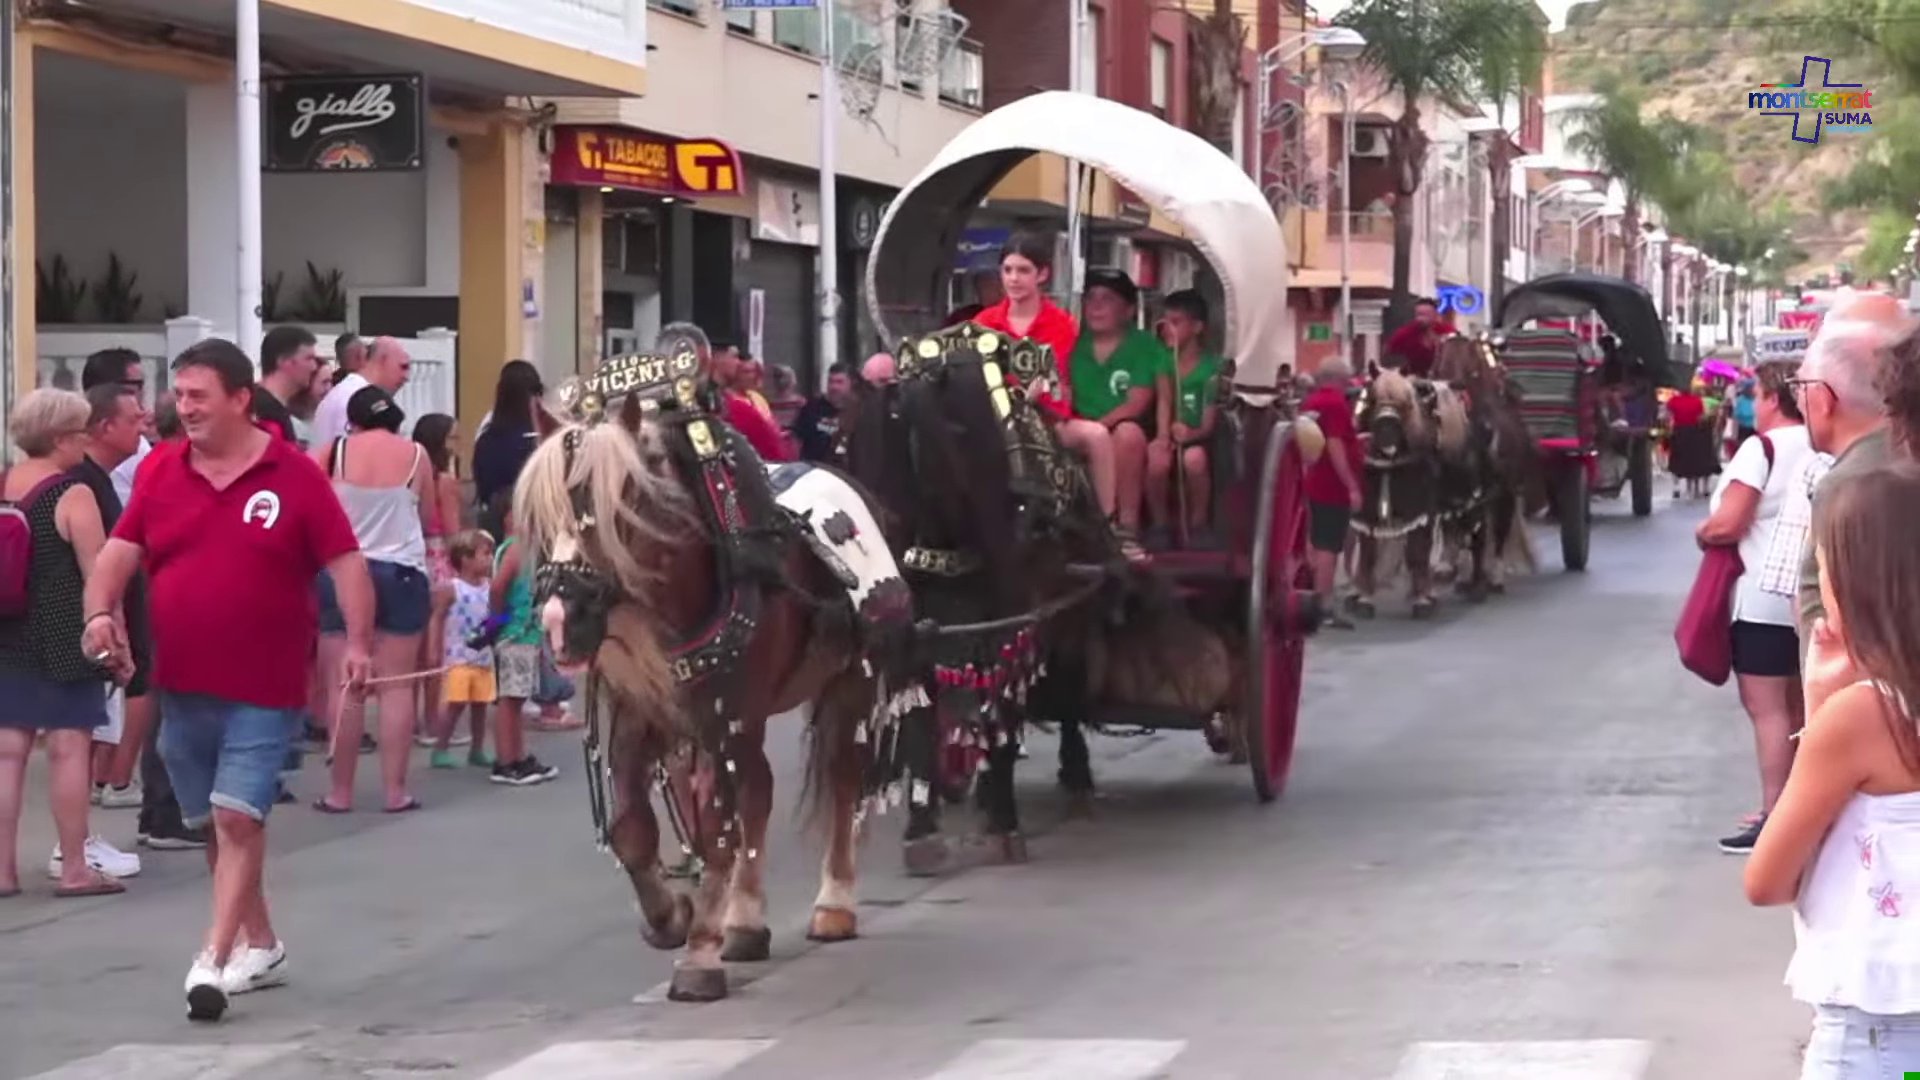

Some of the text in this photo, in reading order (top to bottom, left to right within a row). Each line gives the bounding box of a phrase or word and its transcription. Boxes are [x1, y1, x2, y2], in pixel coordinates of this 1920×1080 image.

[290, 83, 396, 138] giallo
[606, 138, 668, 168] TABACOS
[585, 359, 666, 392] VICENT
